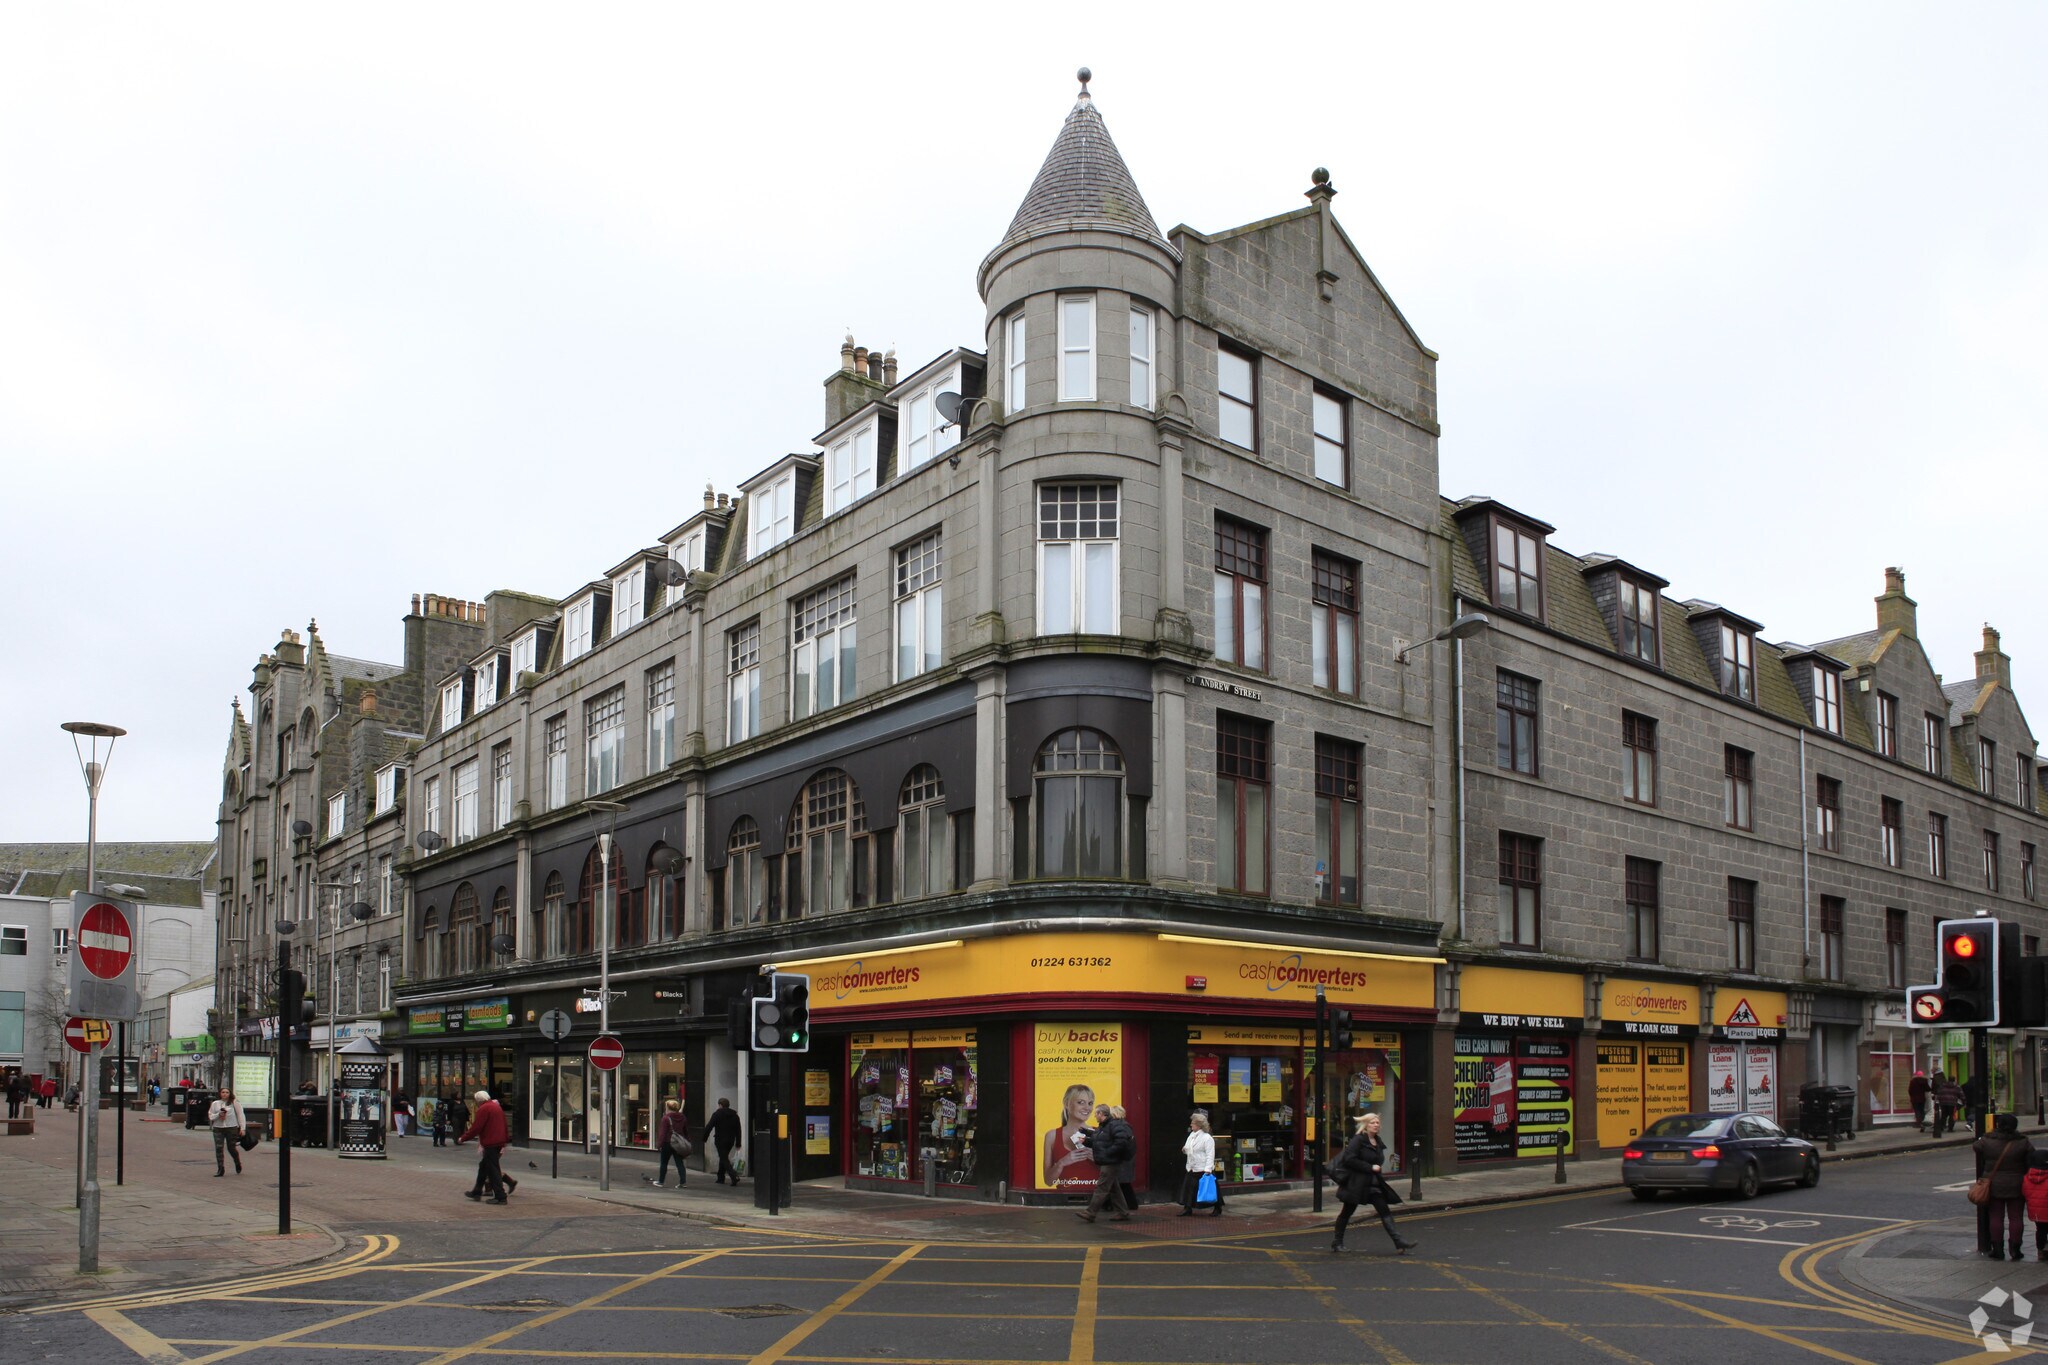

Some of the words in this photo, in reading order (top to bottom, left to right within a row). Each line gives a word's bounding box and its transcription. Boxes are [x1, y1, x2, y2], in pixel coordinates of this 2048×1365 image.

[1186, 676, 1196, 684] ST
[1200, 678, 1230, 692] ANDREW
[1234, 686, 1261, 700] STREET
[1031, 958, 1064, 967] 01224
[1068, 957, 1112, 966] 631362
[816, 966, 920, 992] cashconverters
[1239, 961, 1366, 987] cashconverters
[1614, 992, 1688, 1011] cashconverters
[1483, 1014, 1499, 1026] WE
[1501, 1016, 1520, 1026] BUY
[1527, 1017, 1542, 1028] WE
[1544, 1018, 1564, 1028] SELL
[85, 1022, 104, 1040] H
[1625, 1023, 1638, 1032] WE
[1639, 1024, 1658, 1034] LOAN
[1660, 1025, 1678, 1034] CASH
[1038, 1030, 1066, 1045] buy
[1068, 1030, 1118, 1042] backs
[1224, 1031, 1240, 1039] Send
[1279, 1034, 1298, 1042] money
[1455, 1039, 1471, 1053] NEED
[1472, 1039, 1489, 1053] CASH
[1490, 1040, 1510, 1054] NOW?
[1598, 1047, 1630, 1055] WESTERN
[1709, 1045, 1735, 1055] LogBook
[1746, 1047, 1770, 1056] LogBook
[1038, 1056, 1064, 1064] goods
[1454, 1061, 1495, 1085] CHEQUES
[1454, 1086, 1490, 1109] CASHED
[1494, 1103, 1505, 1114] LOW
[1493, 1113, 1508, 1125] RATES
